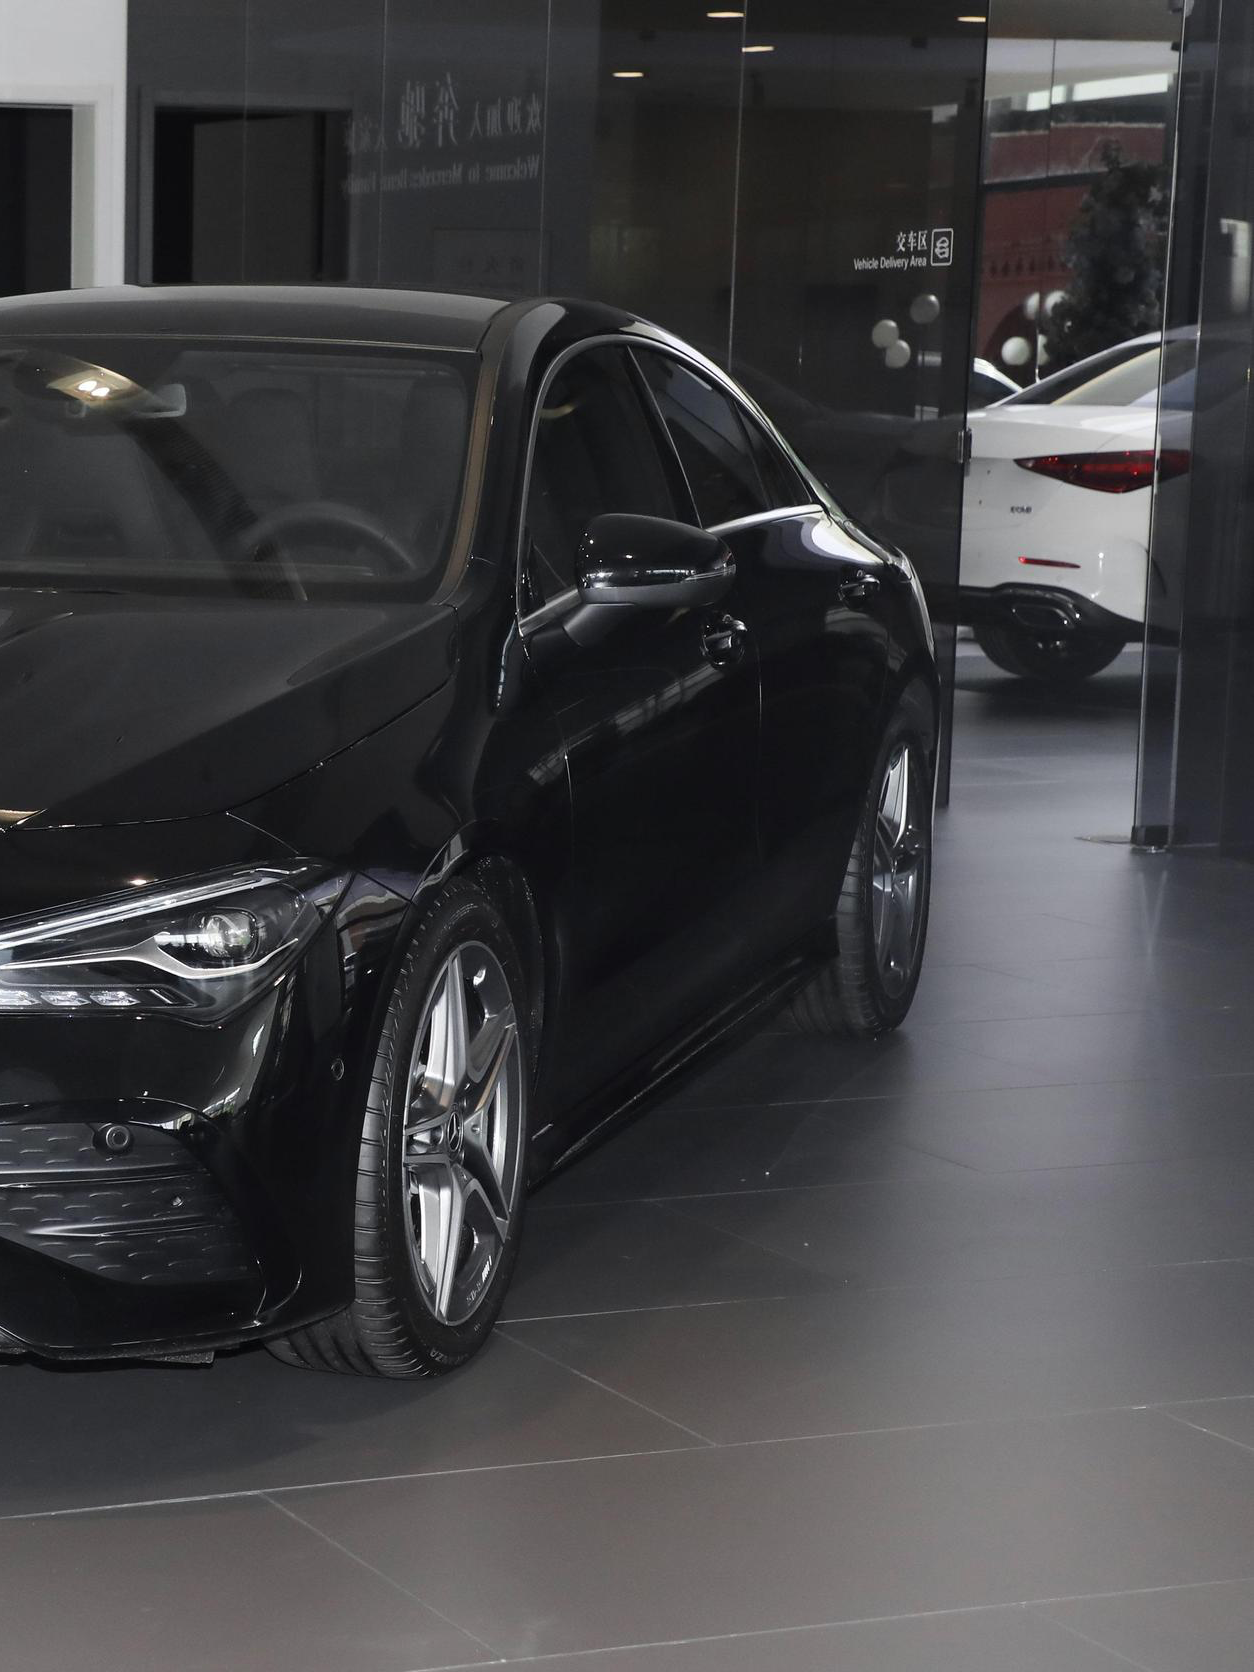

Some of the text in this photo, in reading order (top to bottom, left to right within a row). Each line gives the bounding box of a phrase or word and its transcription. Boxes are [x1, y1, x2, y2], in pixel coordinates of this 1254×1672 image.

[897, 230, 928, 252] 交车区
[853, 255, 927, 270] Vehicle Delivery Area
